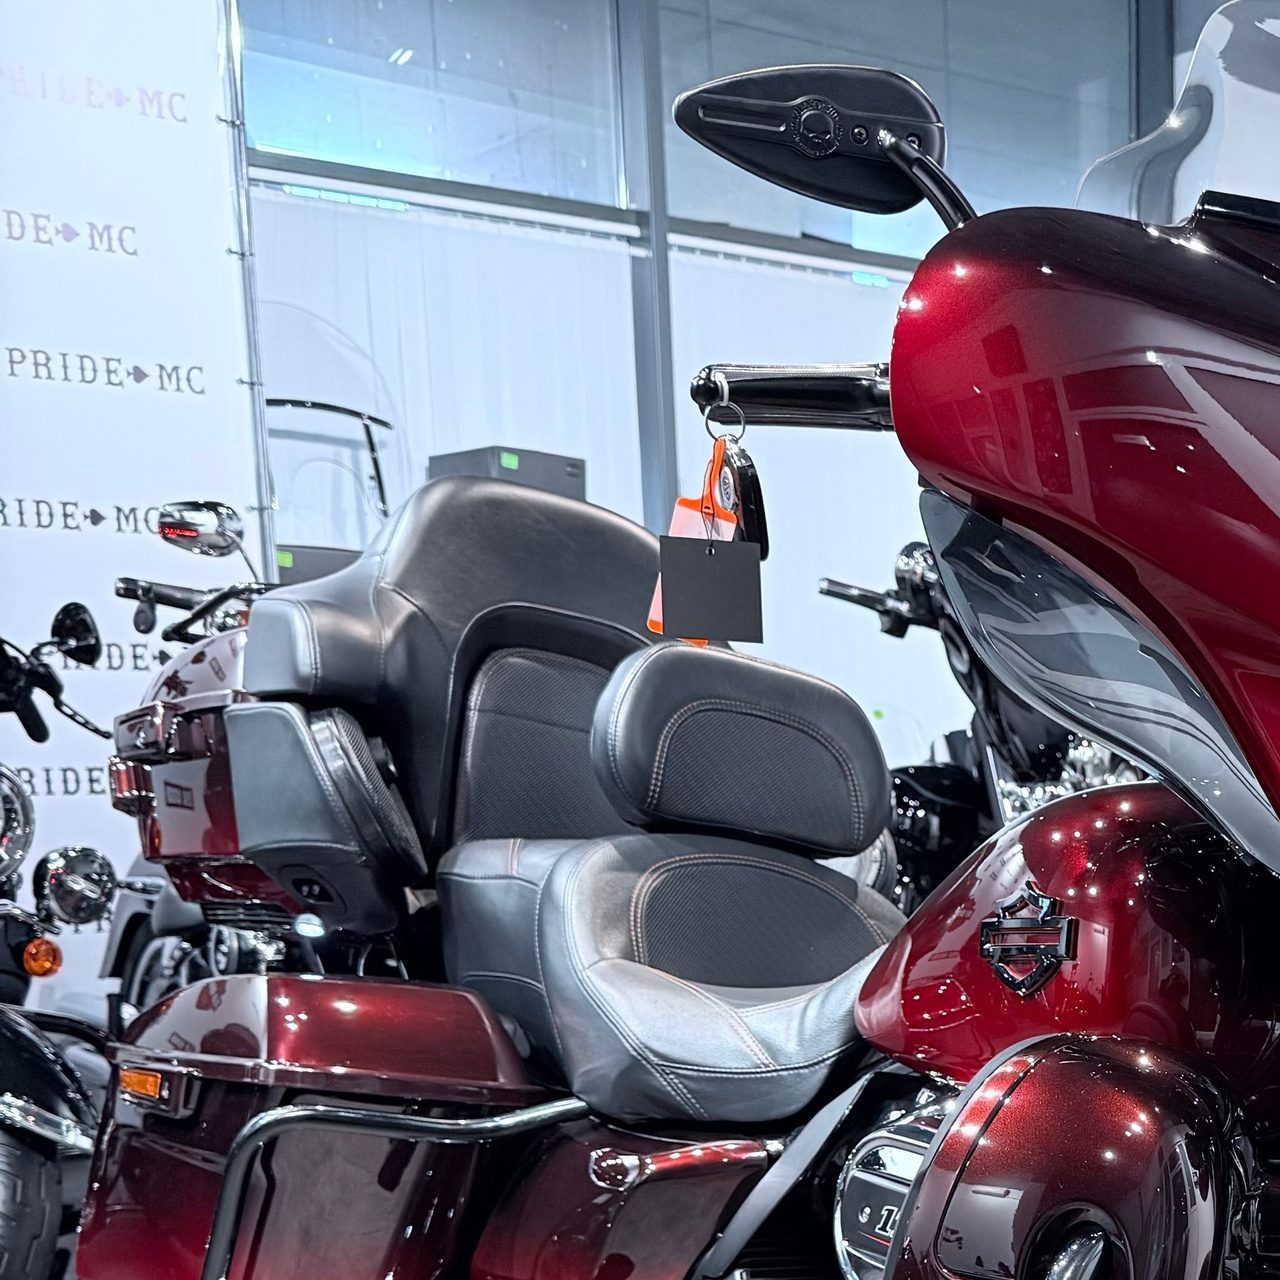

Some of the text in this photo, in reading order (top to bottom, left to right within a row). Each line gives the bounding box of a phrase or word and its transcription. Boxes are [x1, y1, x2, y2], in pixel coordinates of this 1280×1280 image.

[137, 87, 188, 124] MC
[87, 221, 139, 257] MC
[5, 347, 206, 395] PRIDE MC
